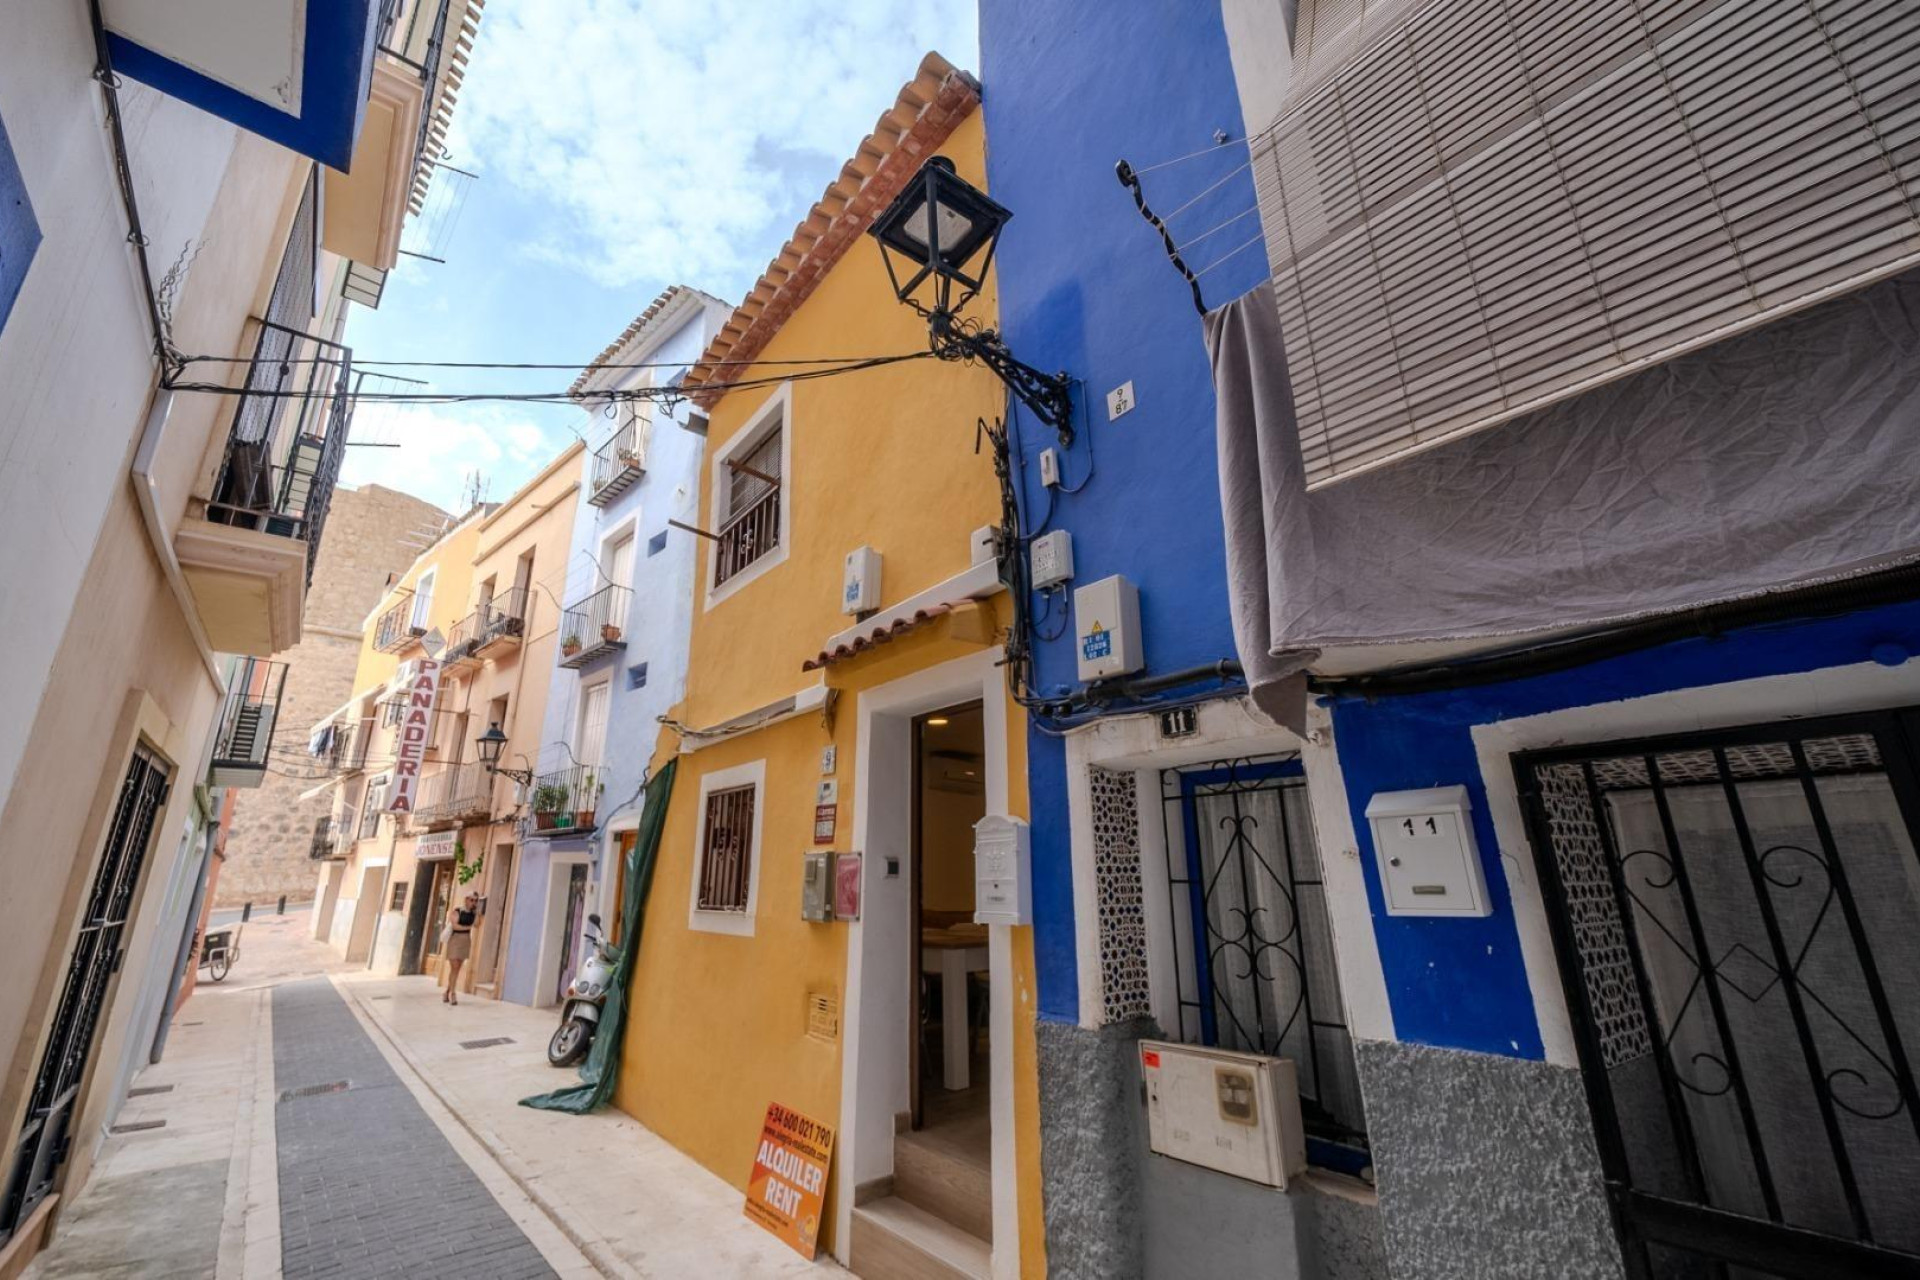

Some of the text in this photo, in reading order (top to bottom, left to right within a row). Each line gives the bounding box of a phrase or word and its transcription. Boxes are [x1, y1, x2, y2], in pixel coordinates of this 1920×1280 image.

[1115, 399, 1128, 415] 87
[1117, 388, 1124, 399] 9
[389, 659, 438, 811] PANADERIA
[1168, 711, 1186, 733] 11
[767, 1106, 831, 1148] +34 600 021 790
[756, 1139, 822, 1196] ALQUILER
[765, 1176, 803, 1219] RENT
